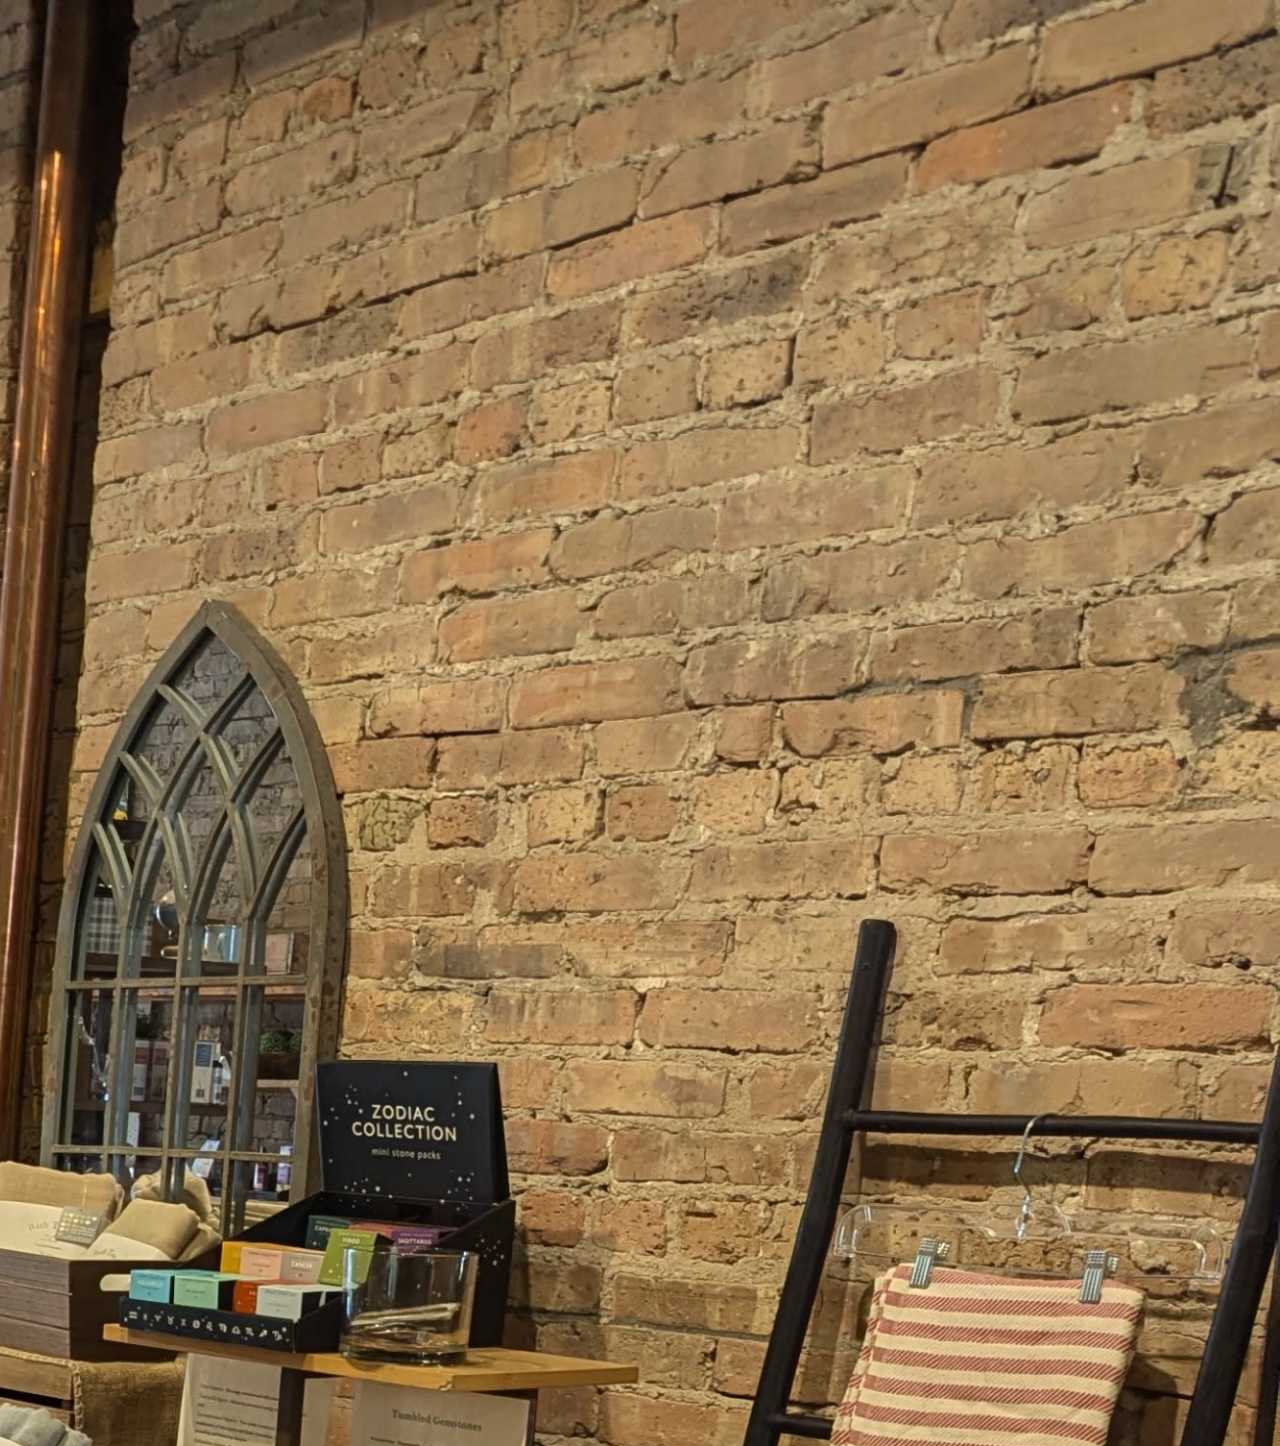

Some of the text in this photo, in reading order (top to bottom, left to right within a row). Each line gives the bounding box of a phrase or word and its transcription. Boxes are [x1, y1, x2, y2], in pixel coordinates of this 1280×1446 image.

[371, 1104, 436, 1122] ZODIAC
[351, 1121, 458, 1142] COLLECTION
[371, 1147, 441, 1161] mini stone packs
